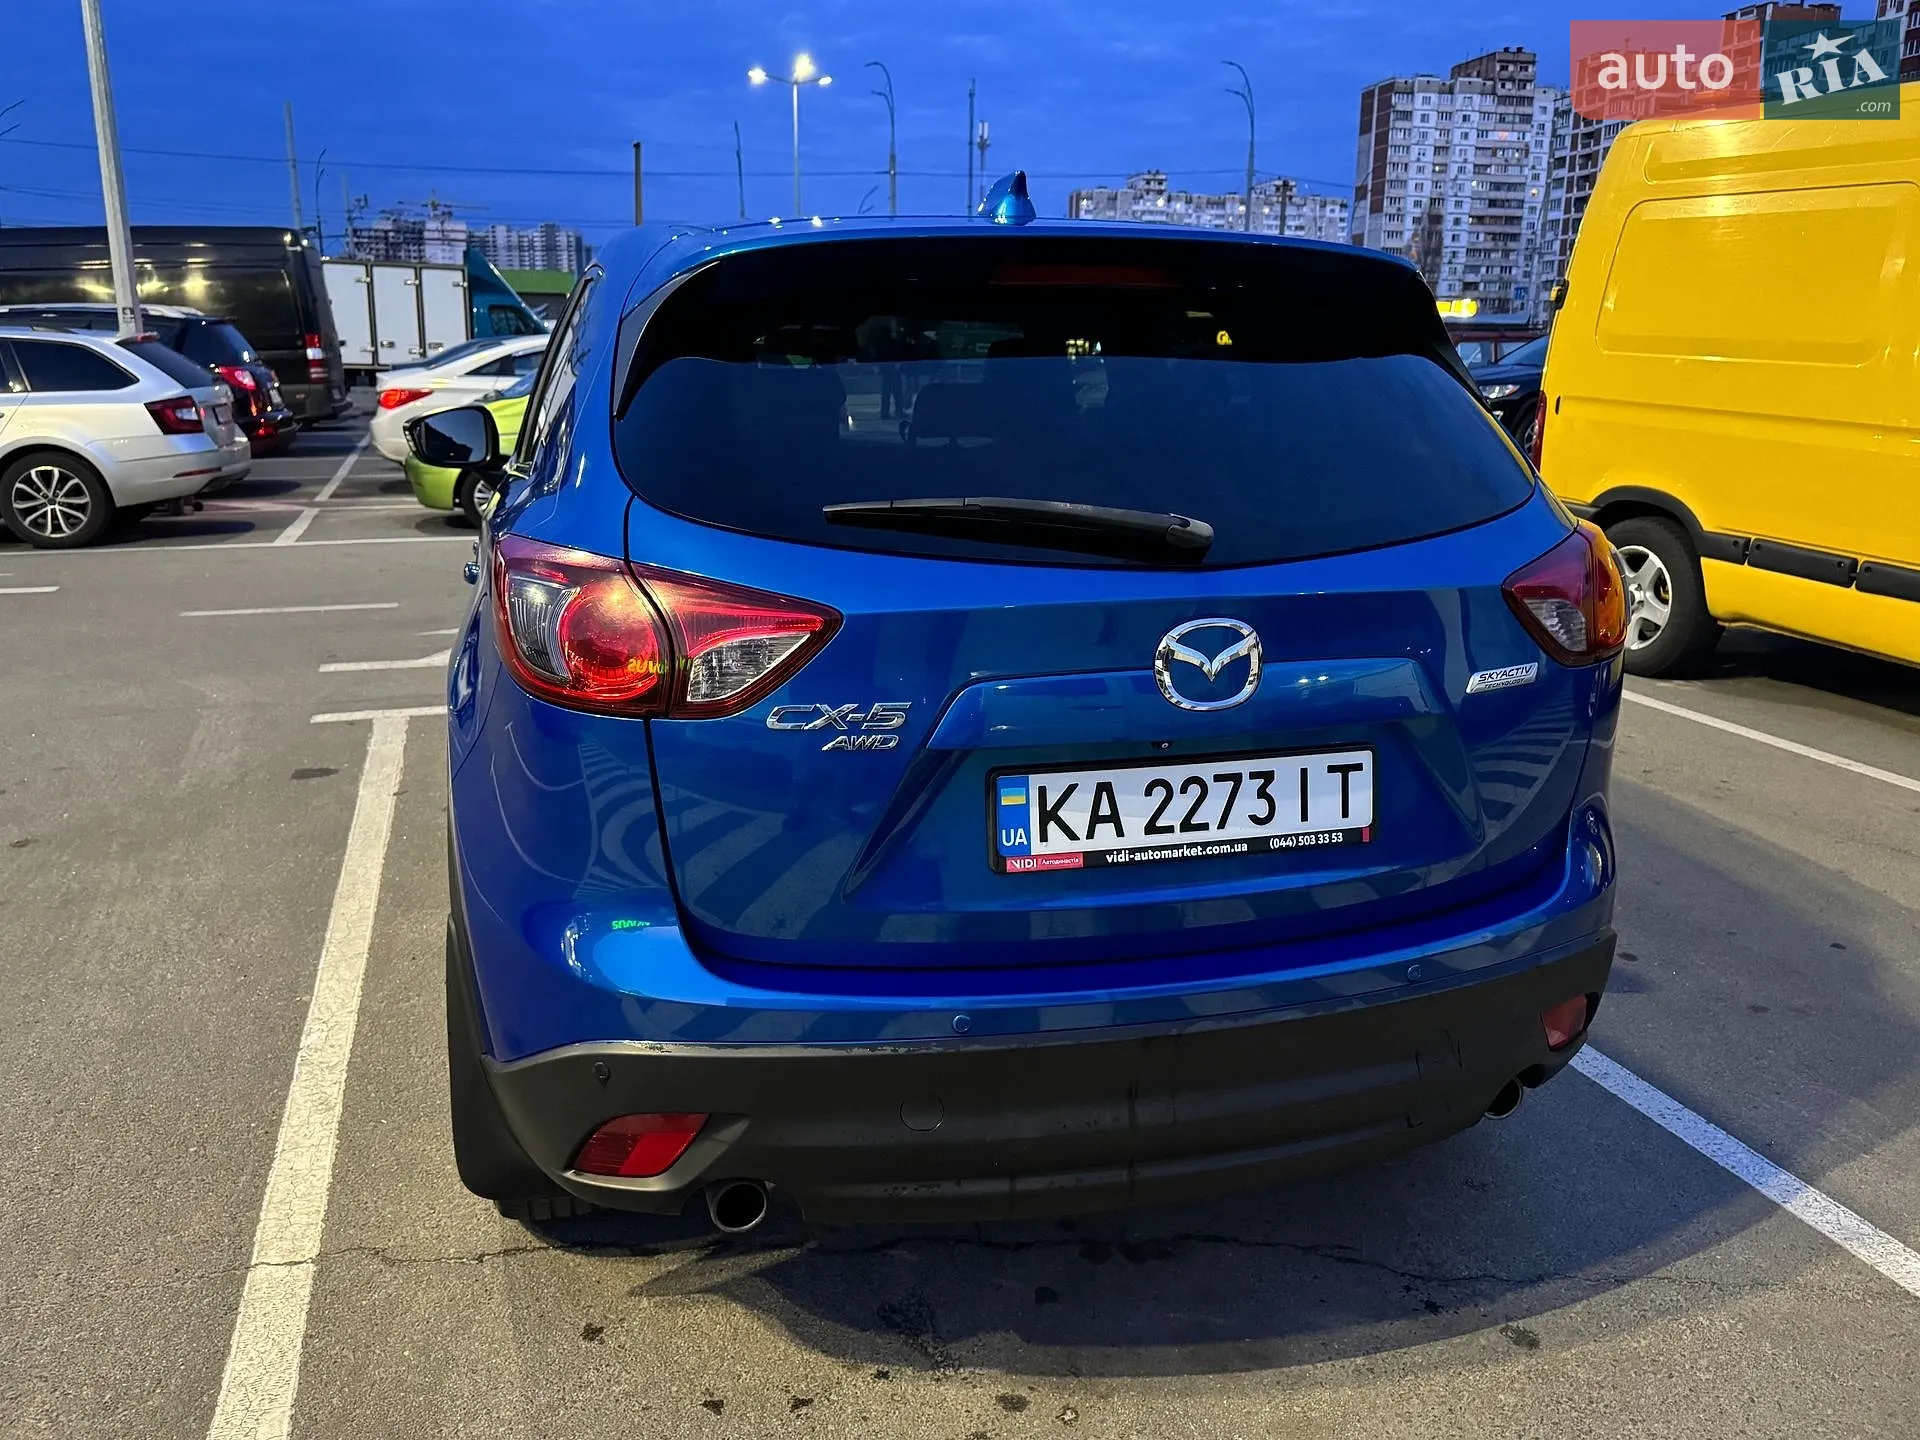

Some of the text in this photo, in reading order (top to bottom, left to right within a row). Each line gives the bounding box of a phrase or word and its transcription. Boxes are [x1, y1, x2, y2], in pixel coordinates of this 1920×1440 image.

[1479, 665, 1533, 682] SKYACTIV
[766, 702, 912, 731] CX-5
[821, 734, 899, 752] AWD
[1036, 763, 1364, 844] KA 2273 IT
[1001, 828, 1028, 847] UA
[1269, 832, 1344, 850] (044) 503 33 53
[1105, 842, 1248, 864] vidi-automarket.com.ua
[1010, 858, 1037, 869] VIDI
